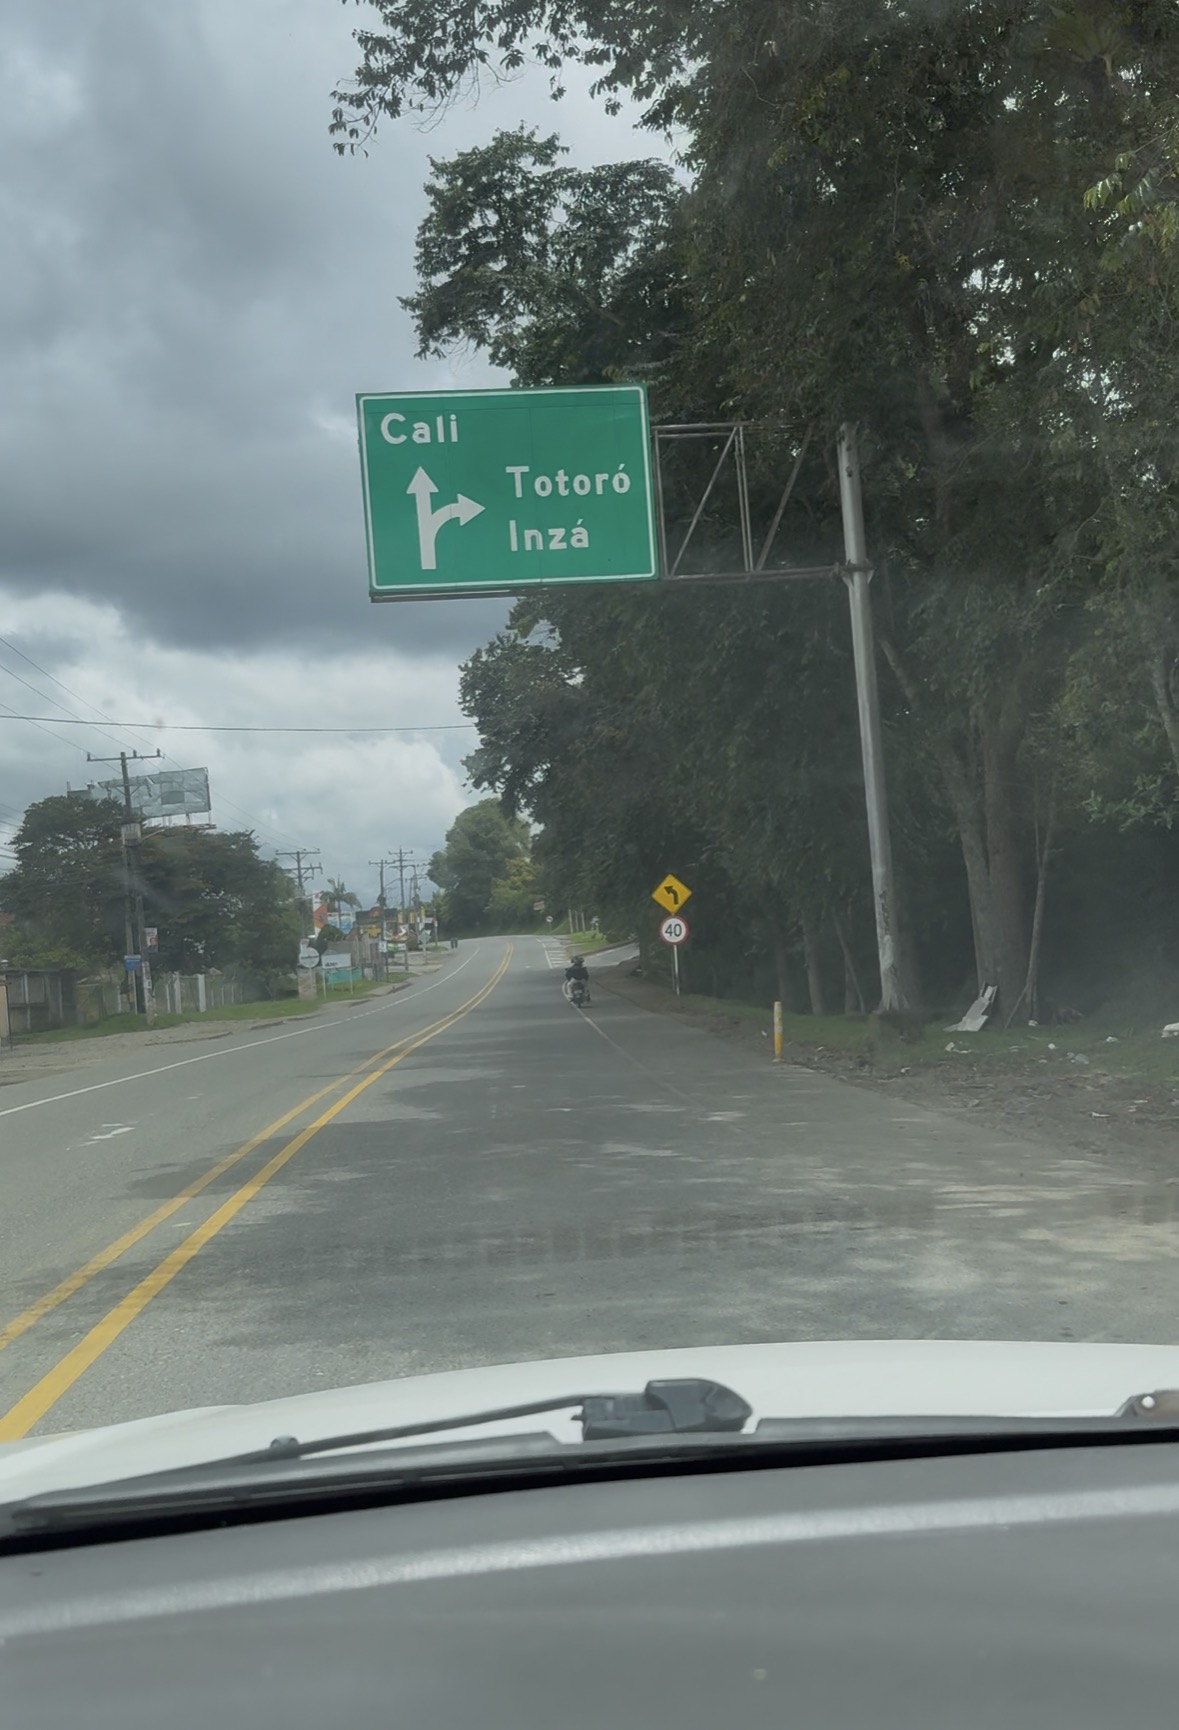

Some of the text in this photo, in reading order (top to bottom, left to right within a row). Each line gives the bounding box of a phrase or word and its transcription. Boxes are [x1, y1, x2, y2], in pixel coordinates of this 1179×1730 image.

[380, 412, 459, 444] Cali
[505, 463, 631, 498] Totoró
[509, 518, 589, 552] Inzá
[664, 922, 682, 938] 40
